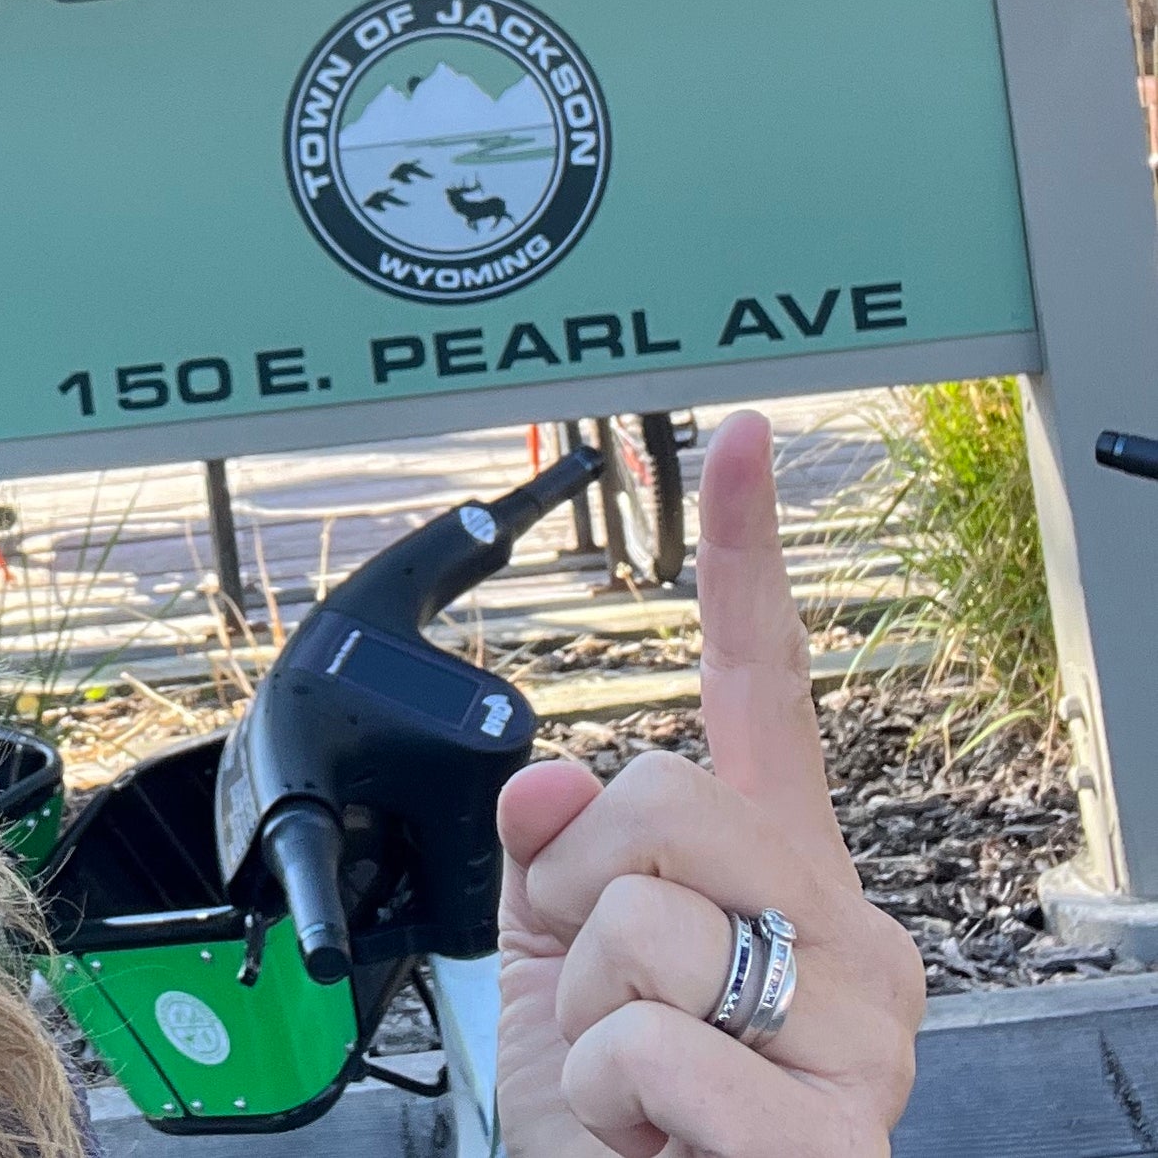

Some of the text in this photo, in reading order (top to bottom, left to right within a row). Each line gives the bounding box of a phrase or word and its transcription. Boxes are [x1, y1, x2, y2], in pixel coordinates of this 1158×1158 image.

[299, 0, 596, 199] TOWN OF JACKSON
[379, 234, 552, 290] WYOMING
[58, 281, 909, 417] 150 E. PEARL AVE
